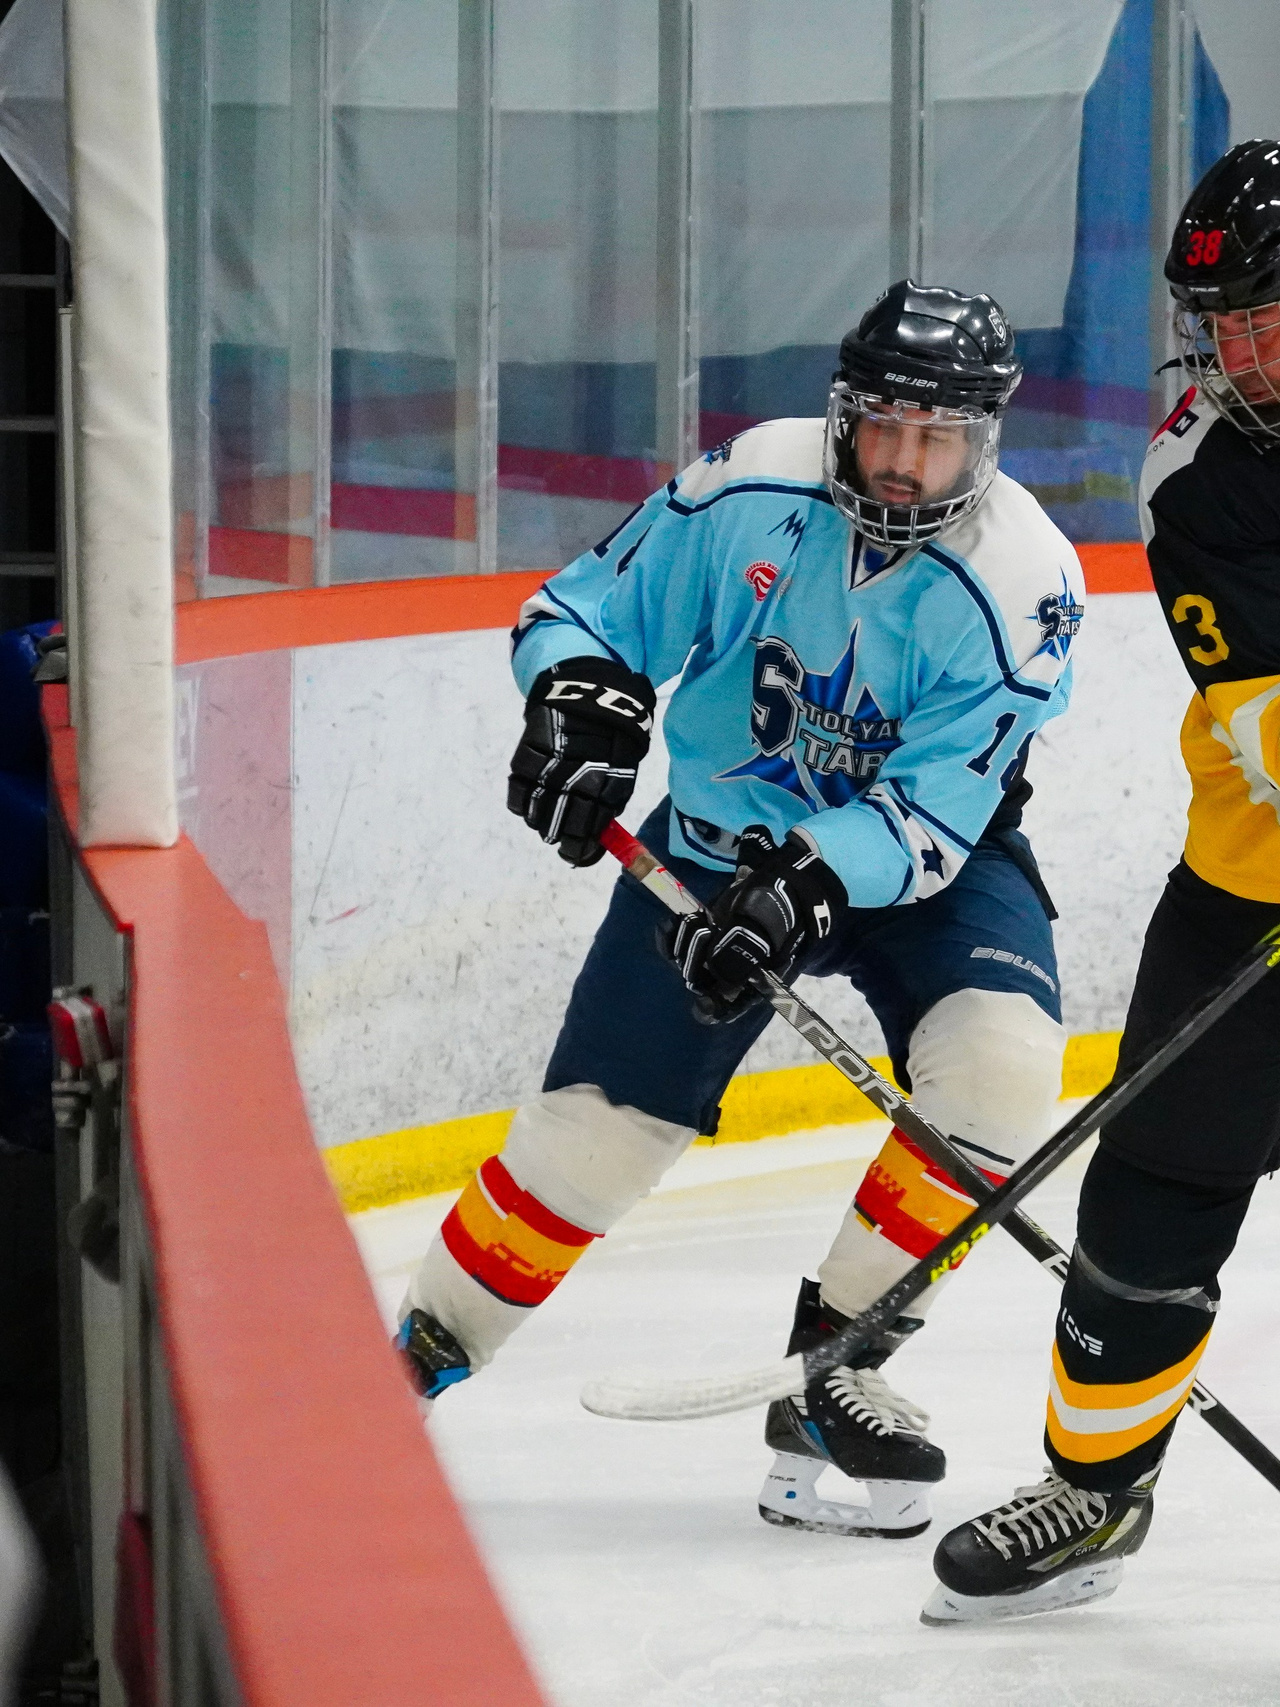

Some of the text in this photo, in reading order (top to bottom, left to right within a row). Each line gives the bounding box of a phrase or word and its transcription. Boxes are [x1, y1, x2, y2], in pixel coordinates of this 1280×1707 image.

[1186, 229, 1224, 266] 38
[884, 371, 939, 389] BAUER
[1171, 593, 1230, 667] 3
[970, 946, 1057, 995] BAUER
[774, 999, 902, 1120] APOR
[768, 1474, 797, 1483] TRUE
